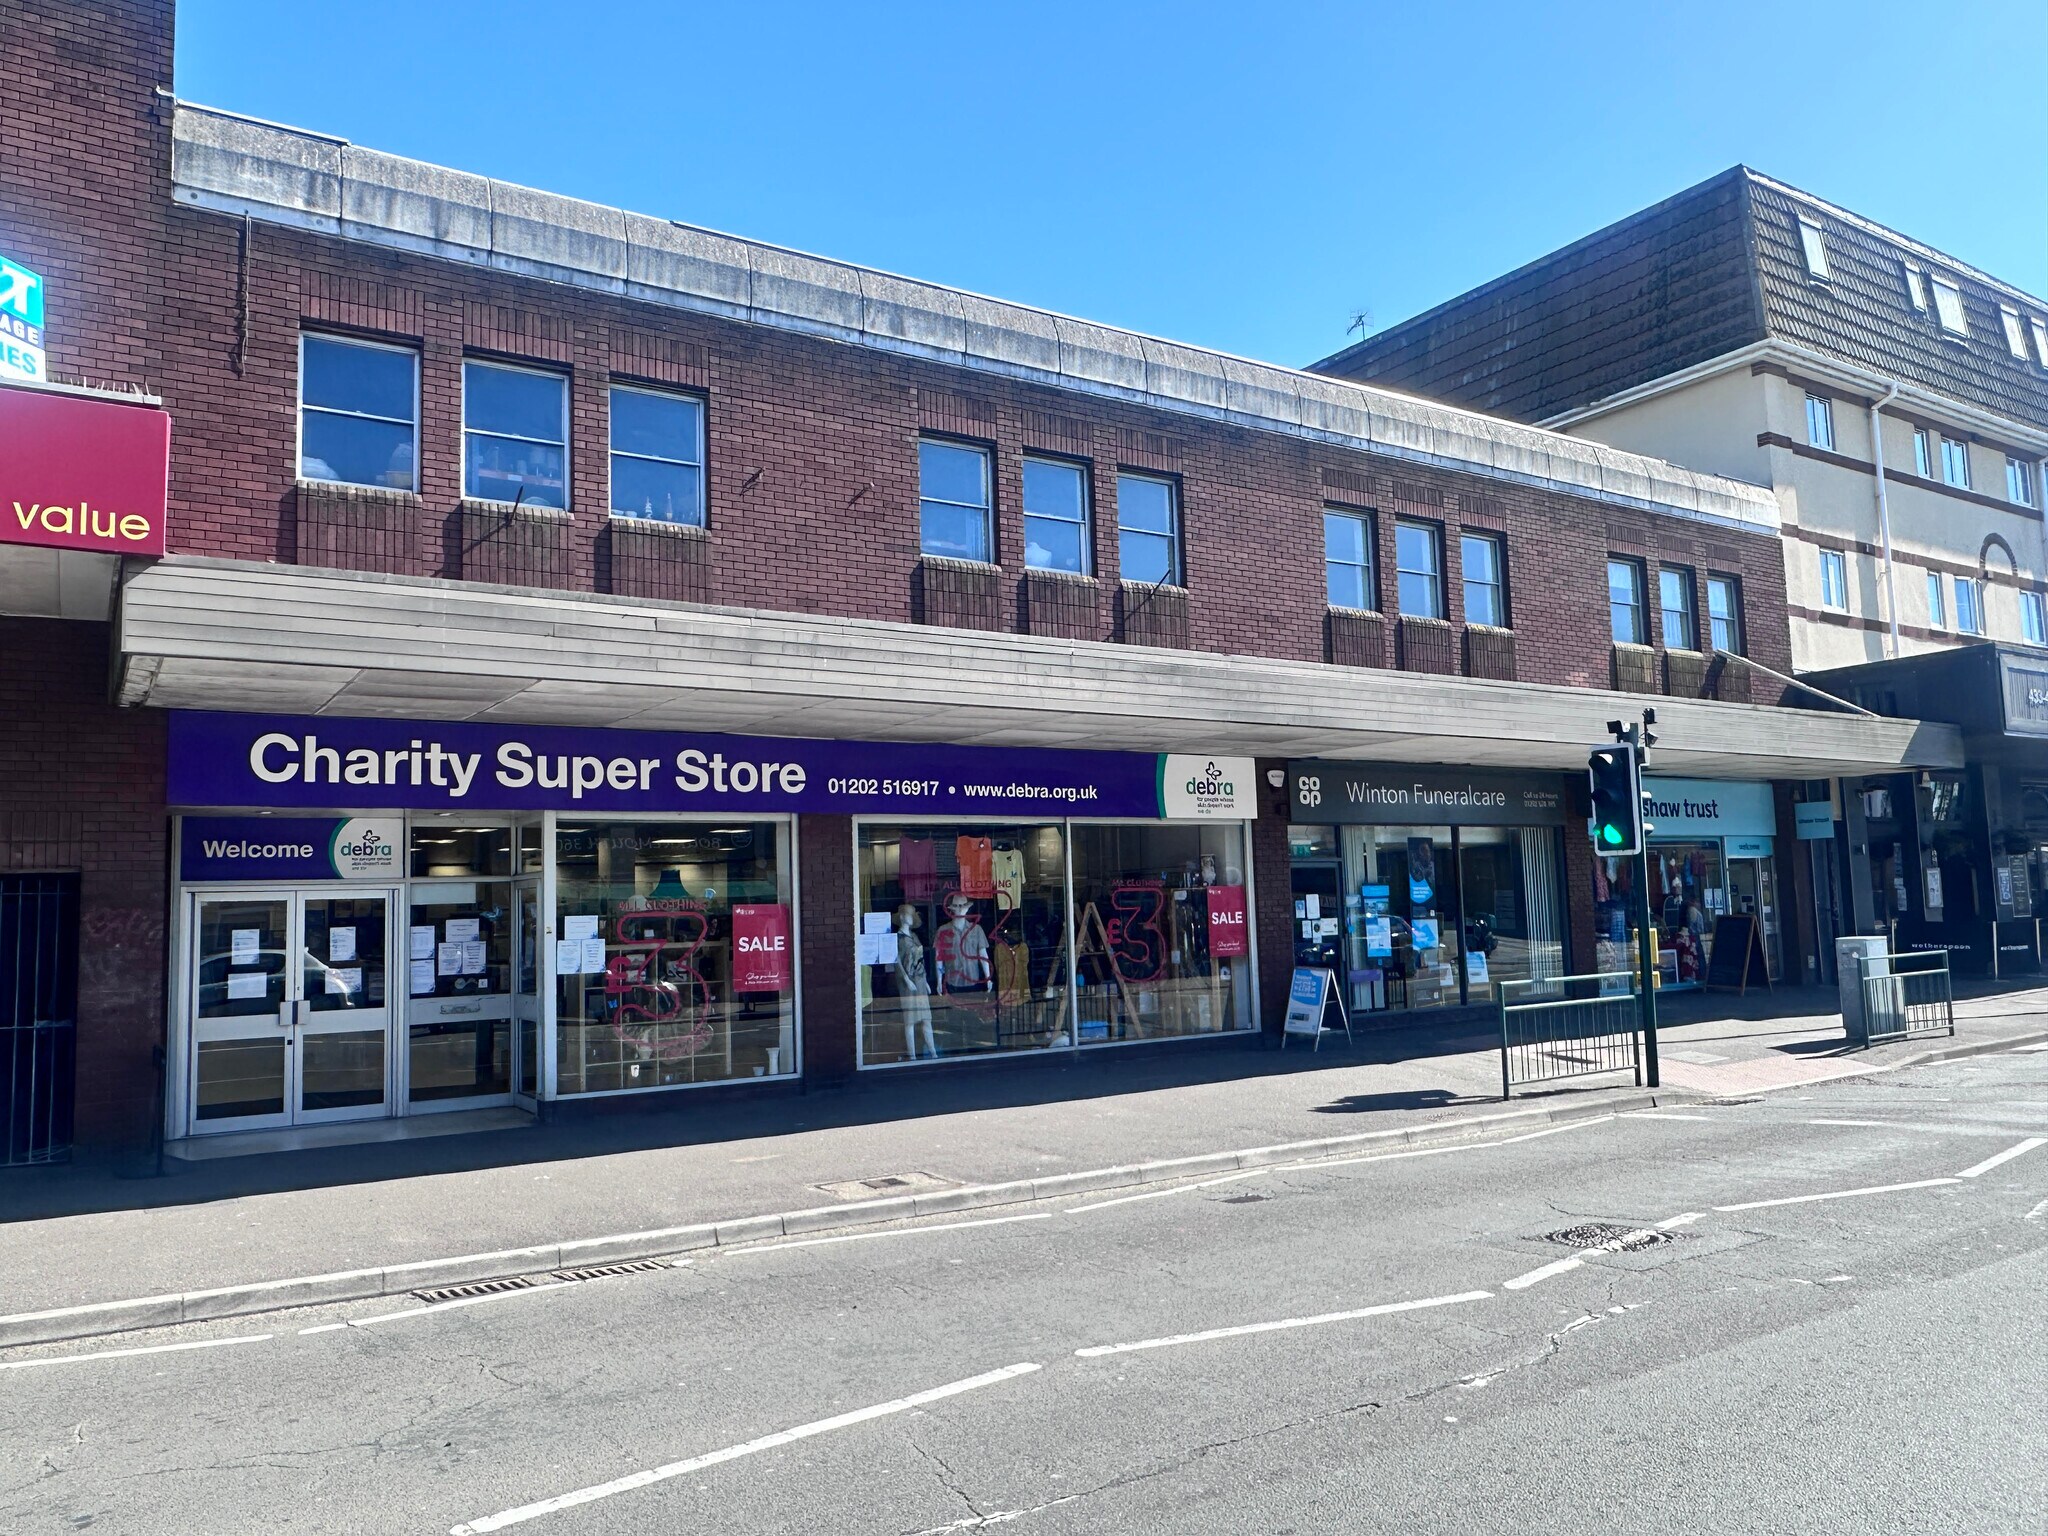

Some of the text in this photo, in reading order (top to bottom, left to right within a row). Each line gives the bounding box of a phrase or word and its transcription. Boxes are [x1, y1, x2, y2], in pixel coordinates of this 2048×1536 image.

[13, 501, 150, 540] value
[250, 733, 806, 799] Charity Super Store
[828, 778, 1098, 802] 01202 516917 www.debra.org.uk
[1186, 777, 1233, 796] debra
[1346, 781, 1506, 807] Winton Funeralcare
[1643, 798, 1719, 819] shaw trust
[203, 840, 313, 858] Welcome
[340, 842, 391, 856] debra
[1211, 911, 1243, 925] SALE
[738, 935, 785, 952] SALE
